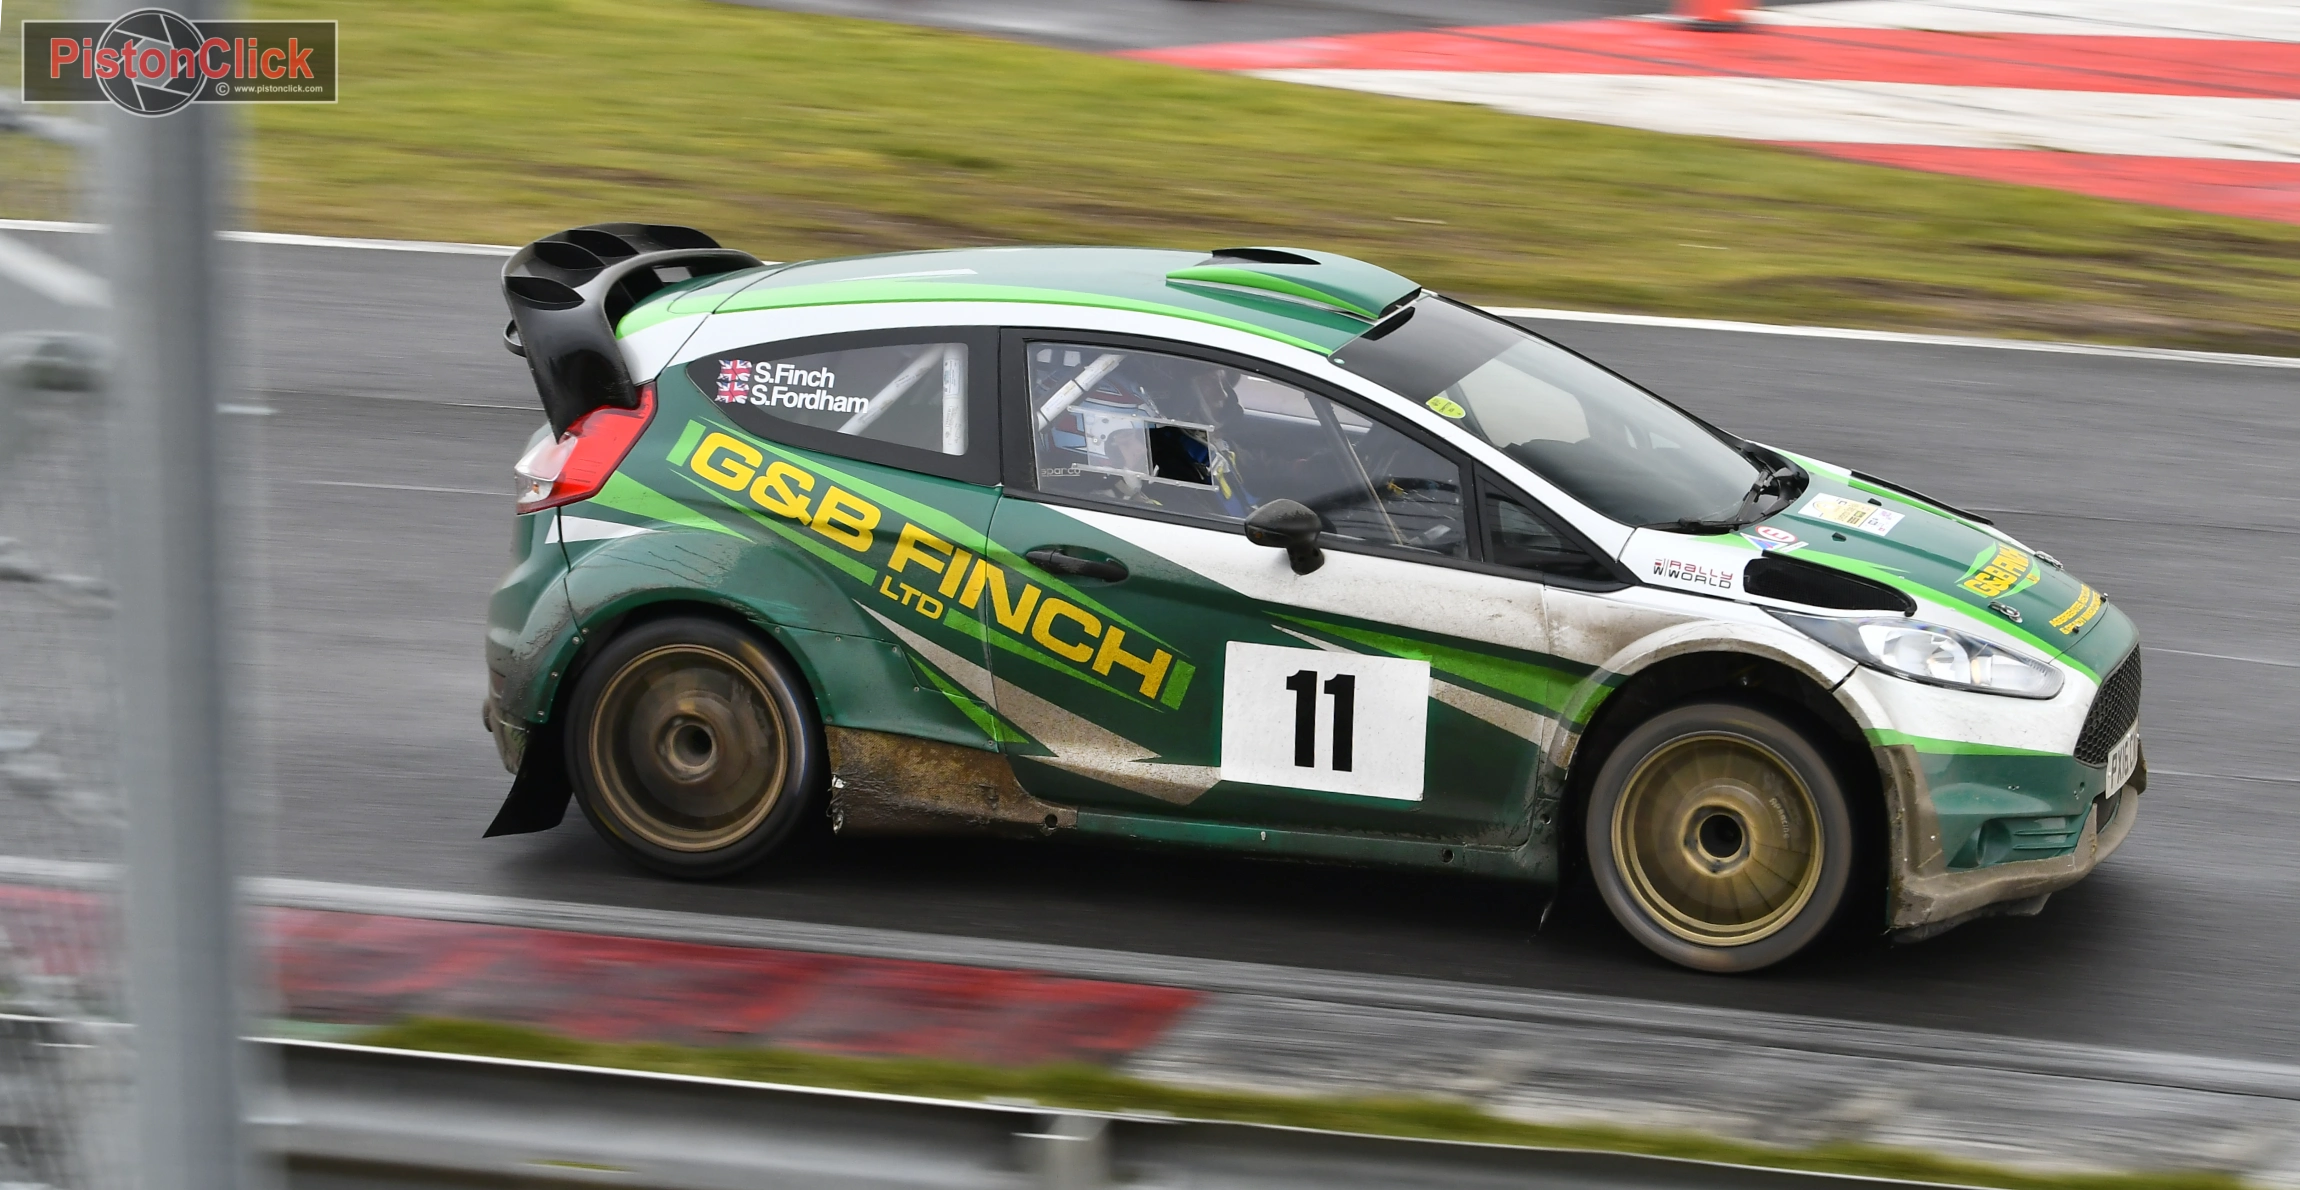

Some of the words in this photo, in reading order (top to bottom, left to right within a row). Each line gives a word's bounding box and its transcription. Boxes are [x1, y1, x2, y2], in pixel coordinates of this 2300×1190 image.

[753, 361, 835, 389] S.Finch
[750, 384, 869, 414] S.Fordham
[690, 432, 882, 552] G&B
[887, 522, 1172, 699] FINCH
[1668, 569, 1732, 589] WORLD
[879, 576, 945, 620] LTD
[1286, 669, 1355, 772] 11
